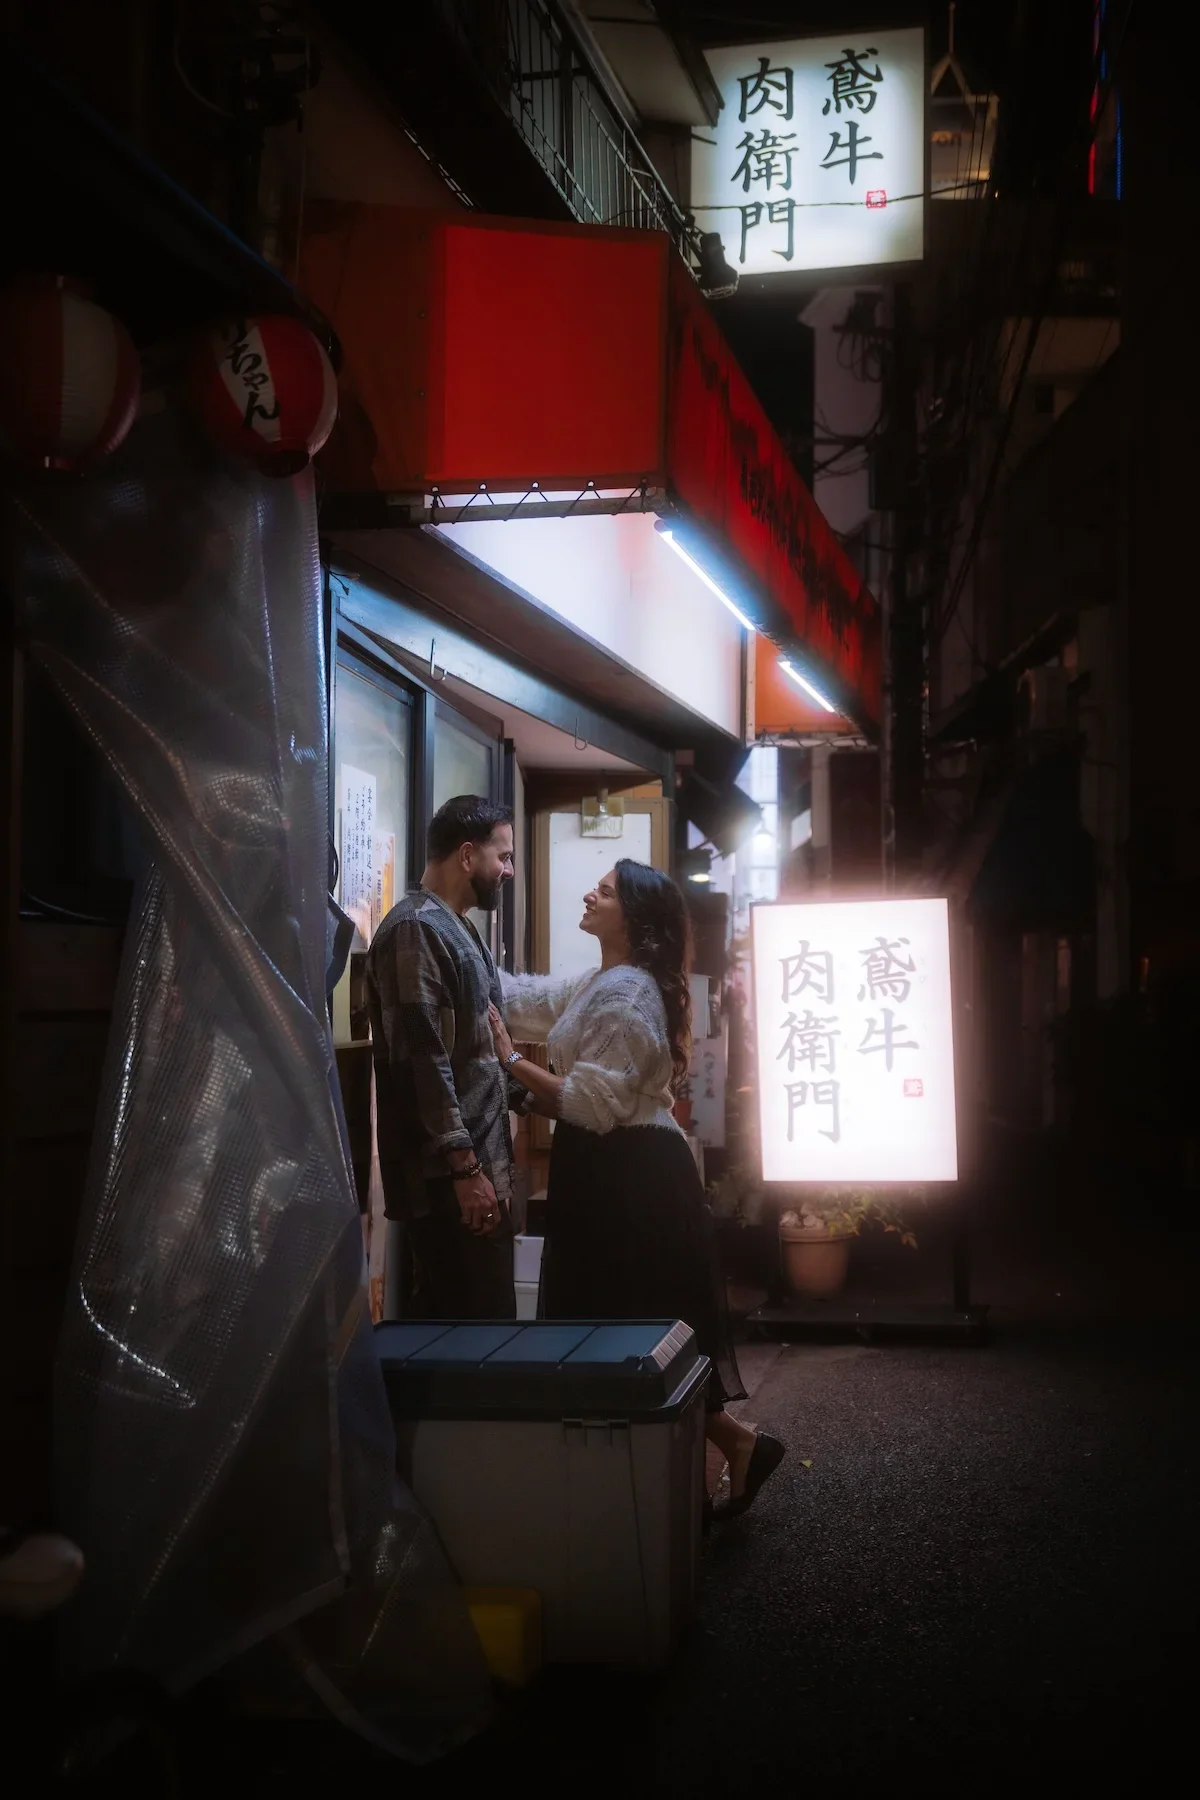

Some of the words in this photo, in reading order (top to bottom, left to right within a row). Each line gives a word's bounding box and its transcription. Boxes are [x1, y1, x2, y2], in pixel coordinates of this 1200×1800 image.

[731, 57, 799, 264] 肉衛門
[820, 46, 884, 185] 鳶牛
[777, 939, 841, 1143] 肉衛門
[856, 935, 920, 1072] 鳶牛
